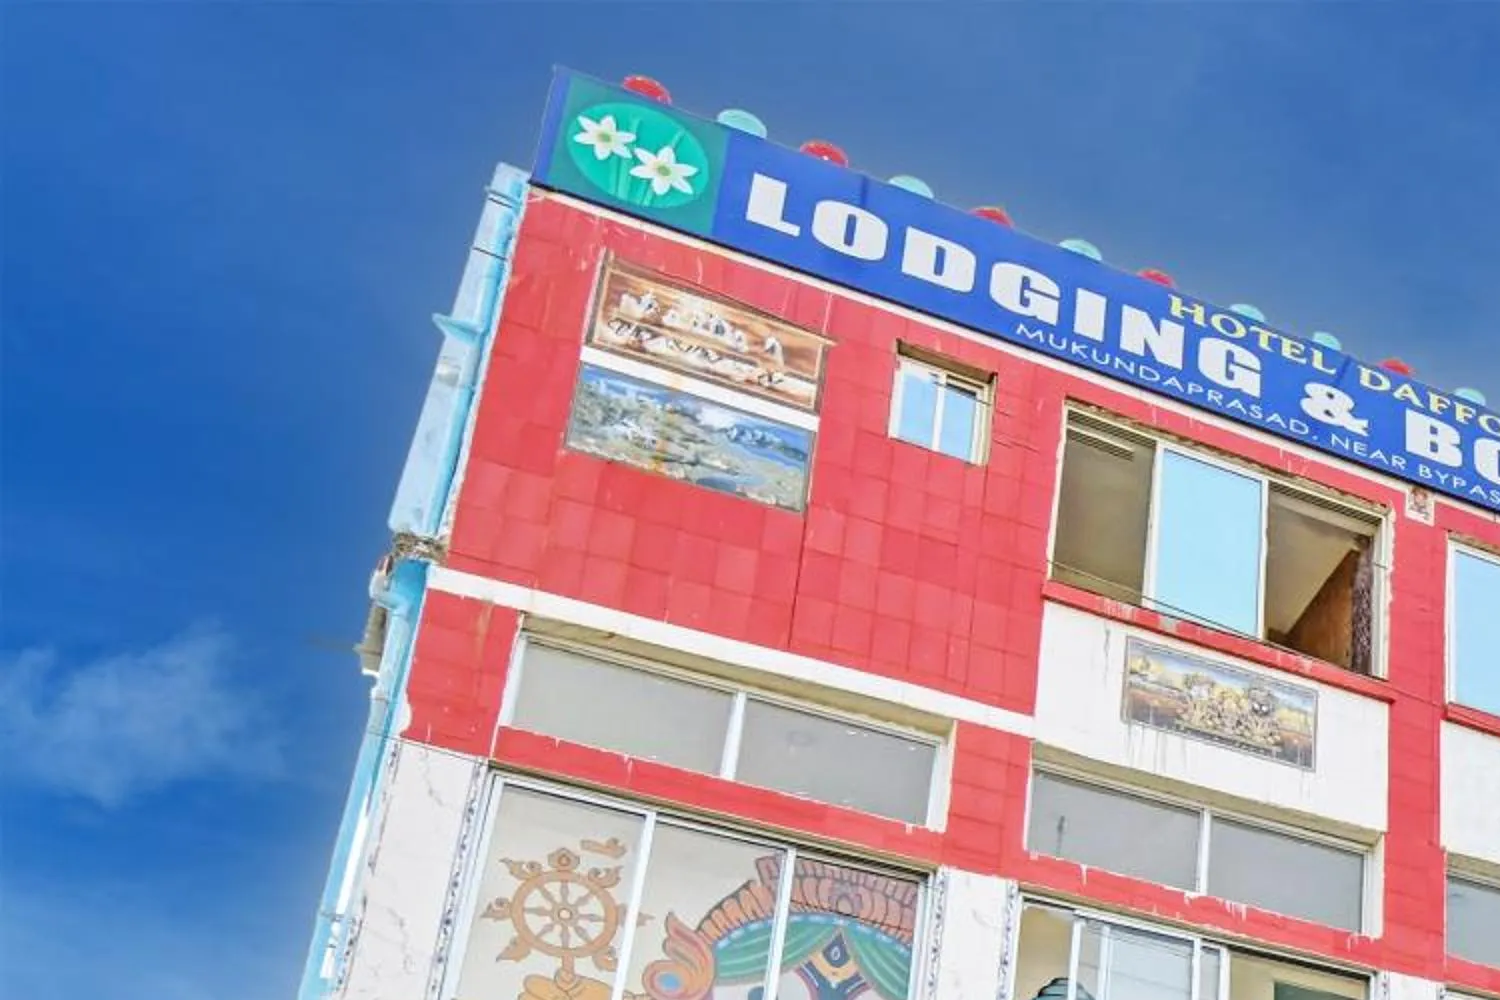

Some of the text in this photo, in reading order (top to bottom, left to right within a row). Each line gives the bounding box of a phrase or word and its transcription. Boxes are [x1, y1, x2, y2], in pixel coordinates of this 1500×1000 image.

[744, 171, 1262, 399] LODGING
[1300, 381, 1370, 437] &
[1167, 292, 1337, 376] HOTEL
[1330, 432, 1408, 470] NEAR
